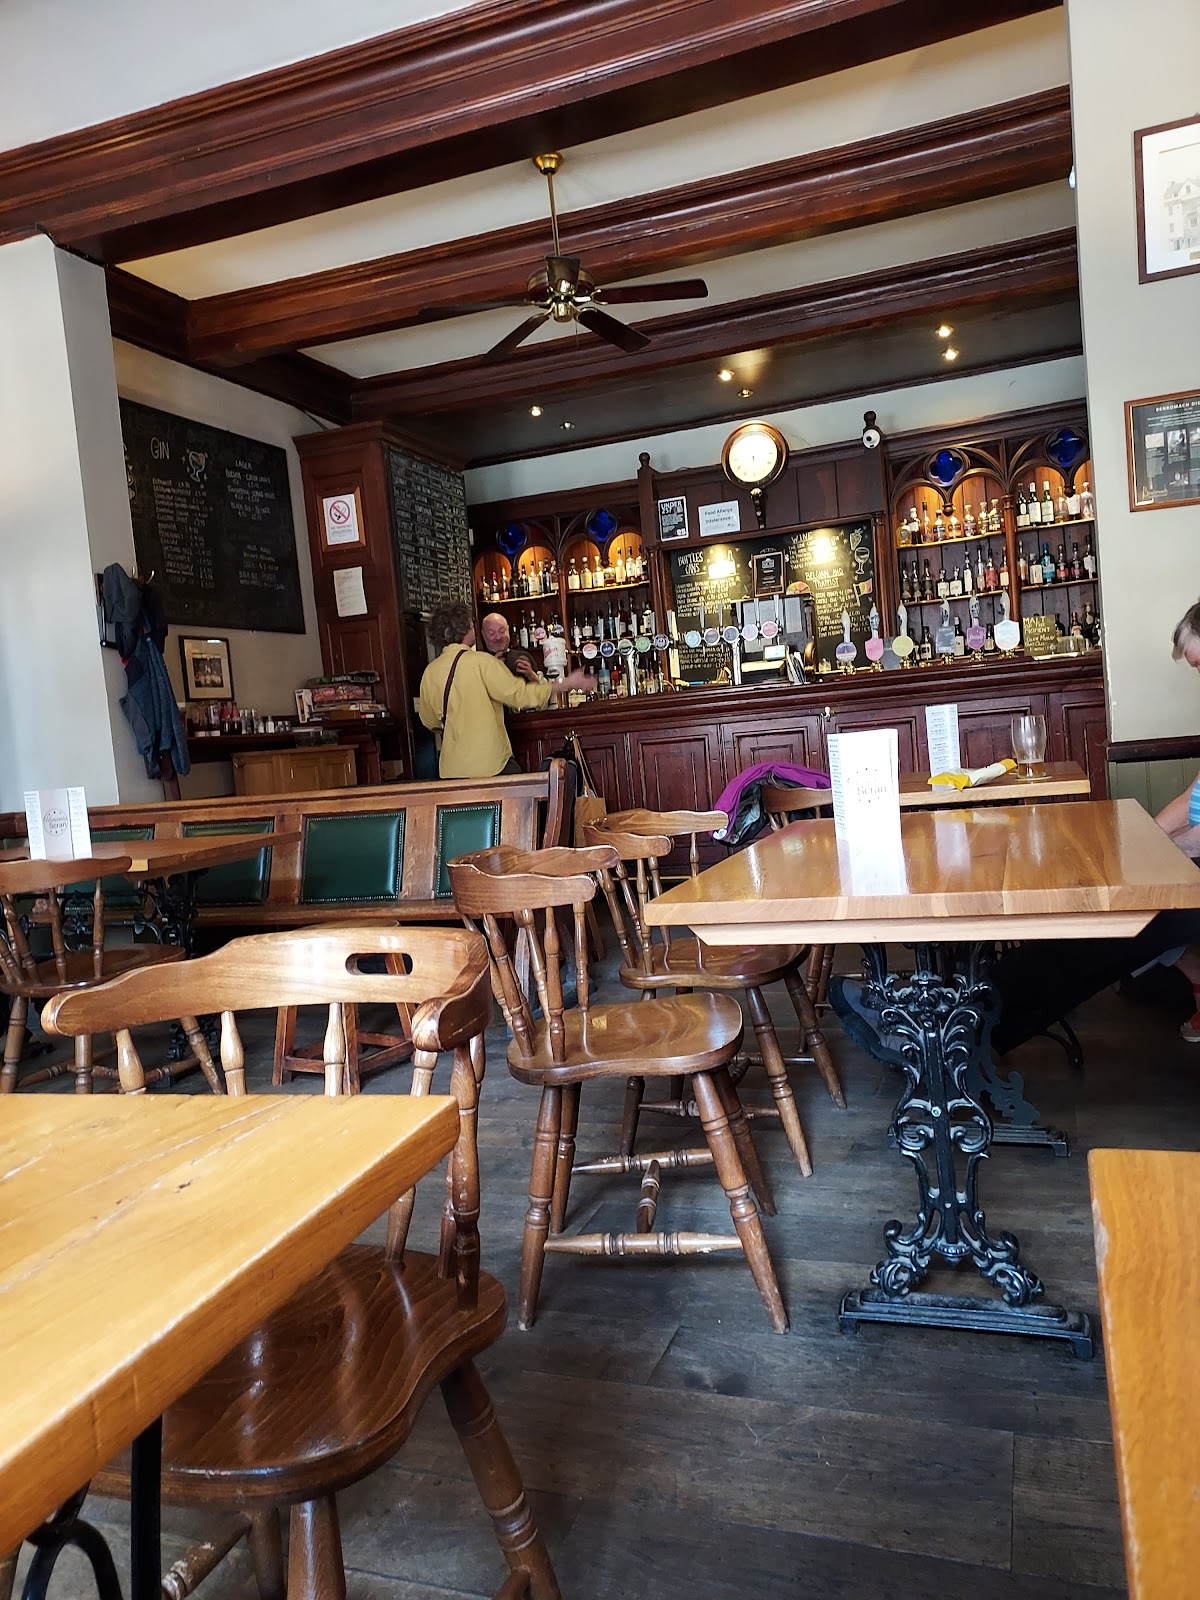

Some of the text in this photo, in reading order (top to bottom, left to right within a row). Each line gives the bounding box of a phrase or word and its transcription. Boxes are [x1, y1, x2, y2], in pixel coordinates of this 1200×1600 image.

[150, 436, 171, 460] GIN
[661, 500, 682, 510] UNDER
[791, 531, 814, 543] WINE
[677, 550, 704, 567] BOTTLES
[1022, 616, 1046, 626] MALT
[1024, 627, 1051, 635] MOMENT
